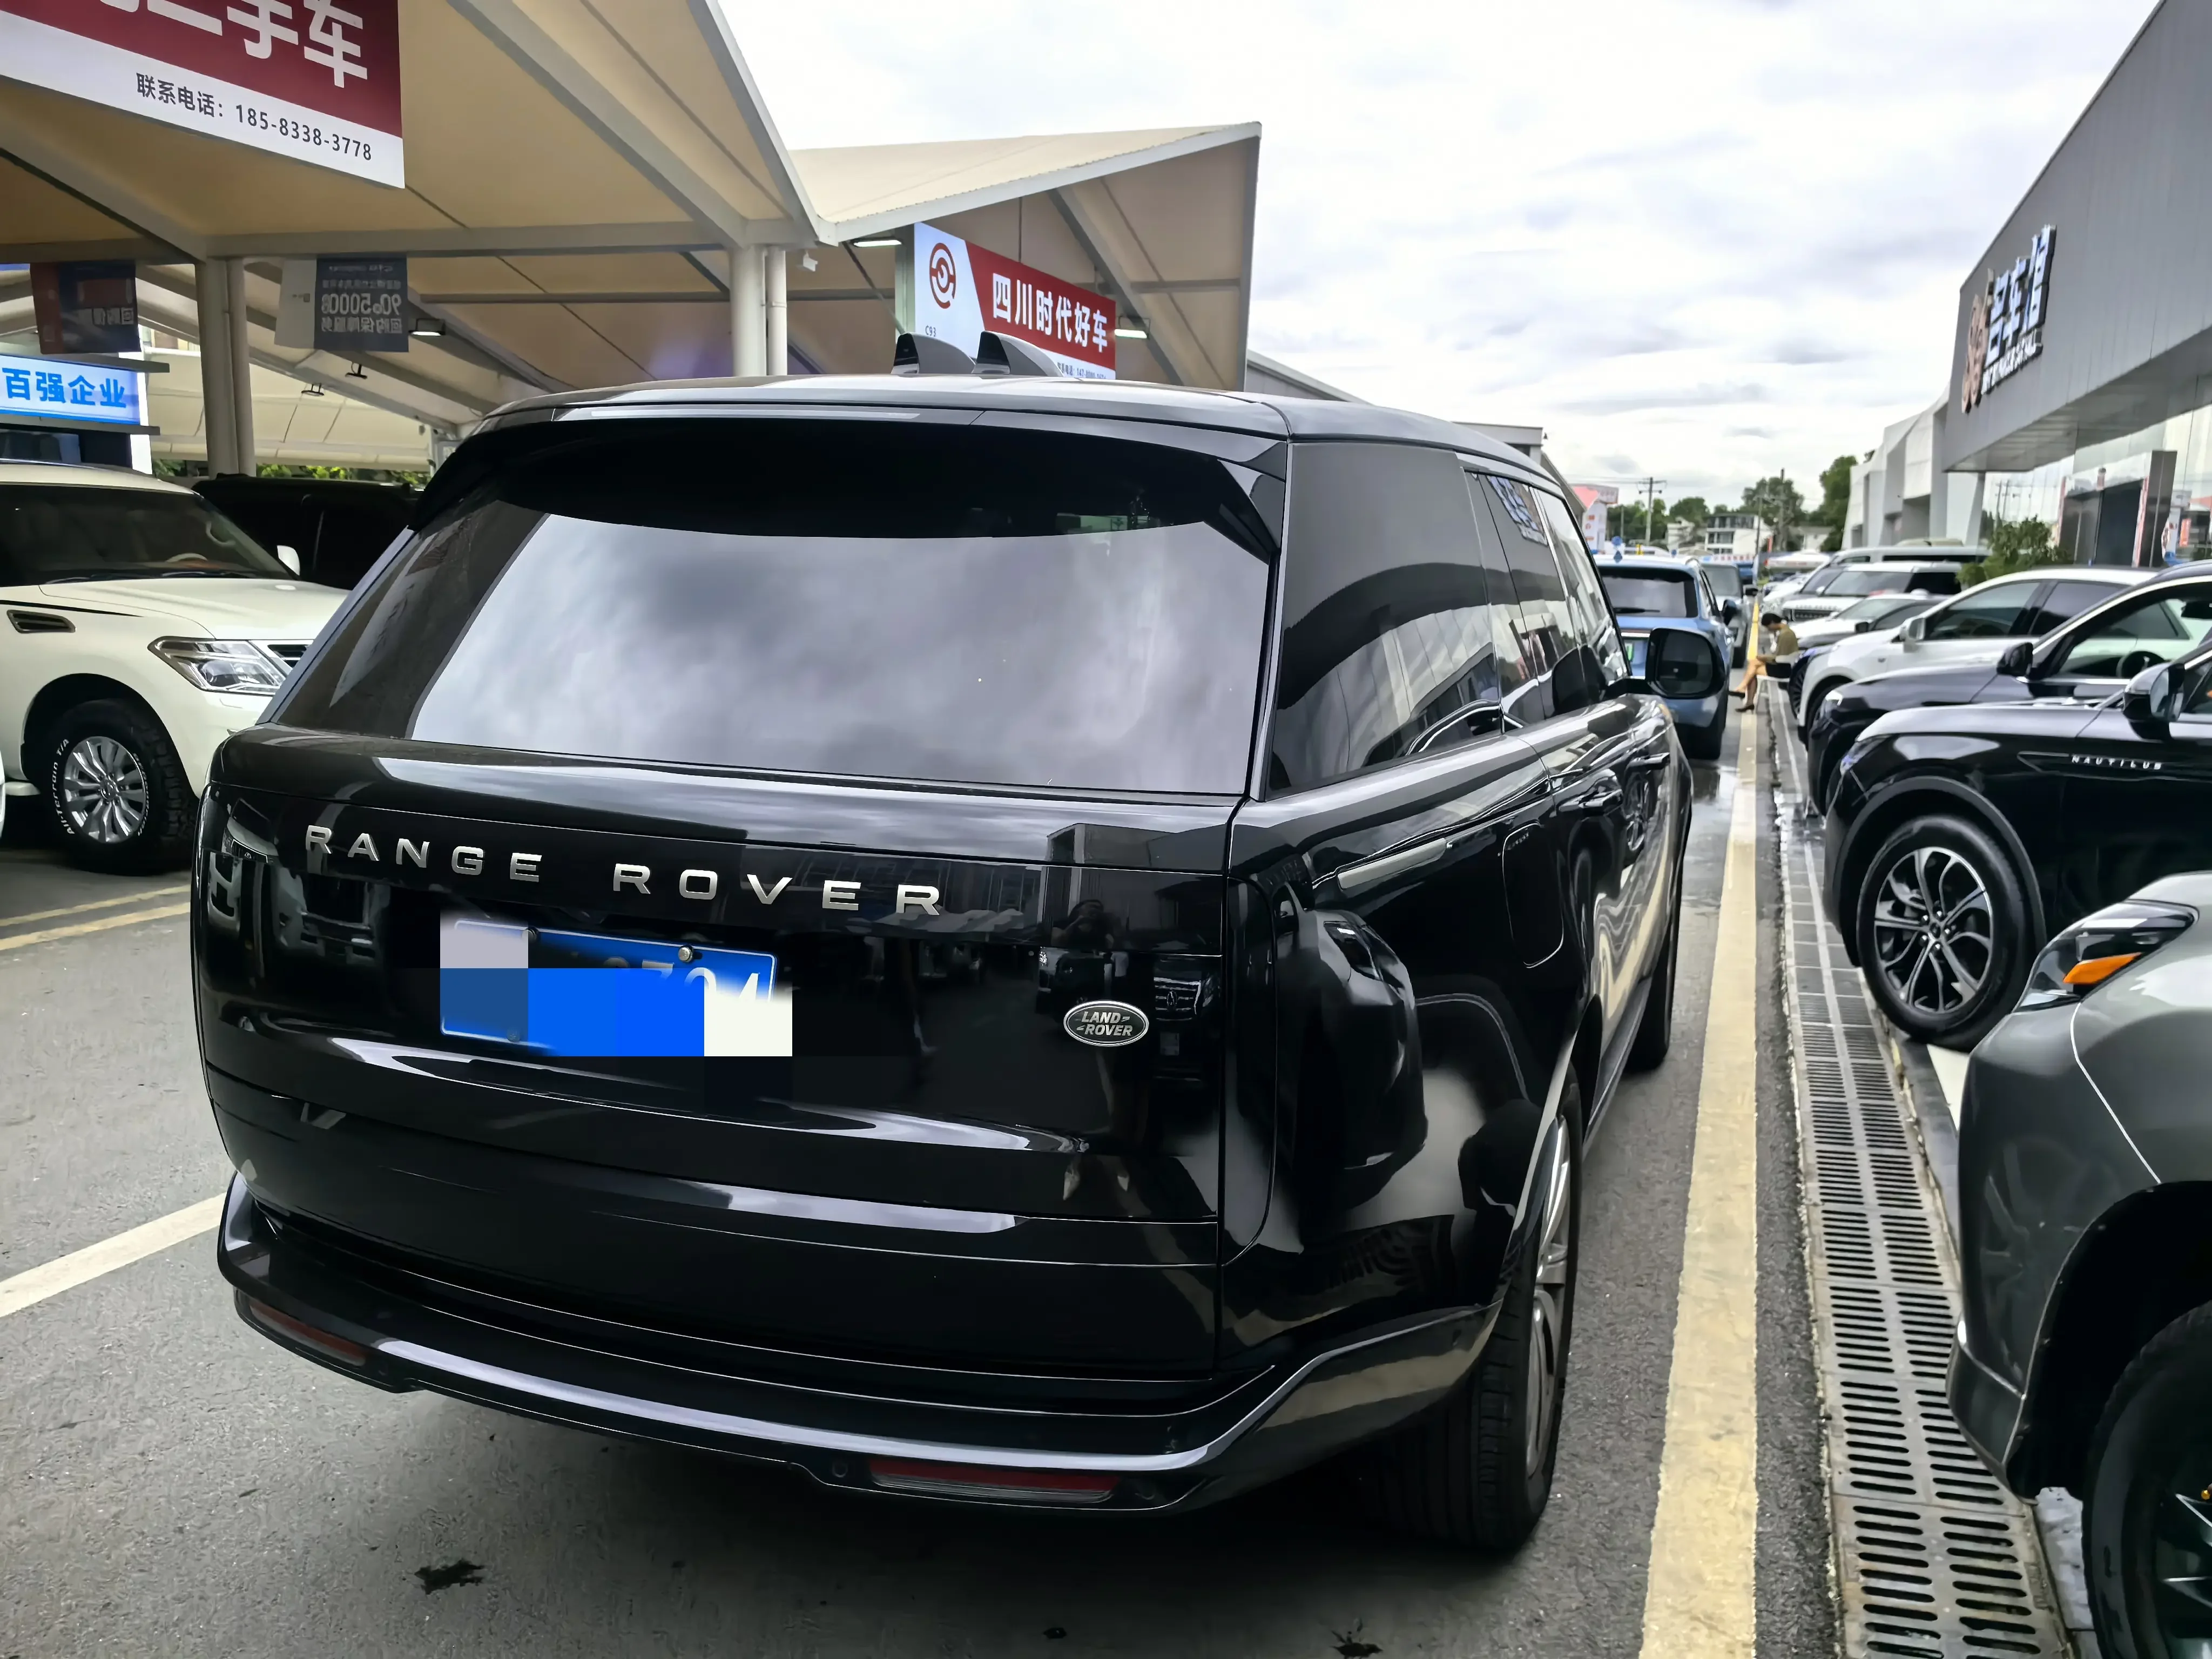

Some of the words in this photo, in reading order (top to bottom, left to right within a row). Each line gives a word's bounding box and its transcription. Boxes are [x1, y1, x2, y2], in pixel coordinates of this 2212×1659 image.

[99, 0, 367, 88] 二手车
[993, 272, 1108, 353] 四川时代好车
[925, 325, 936, 337] C93
[2, 367, 126, 408] 百强企业
[57, 739, 69, 756] T/A
[305, 825, 542, 884] RANGE
[612, 863, 940, 915] ROVER
[1081, 1011, 1121, 1023] LAND
[1085, 1024, 1133, 1036] ROVER
